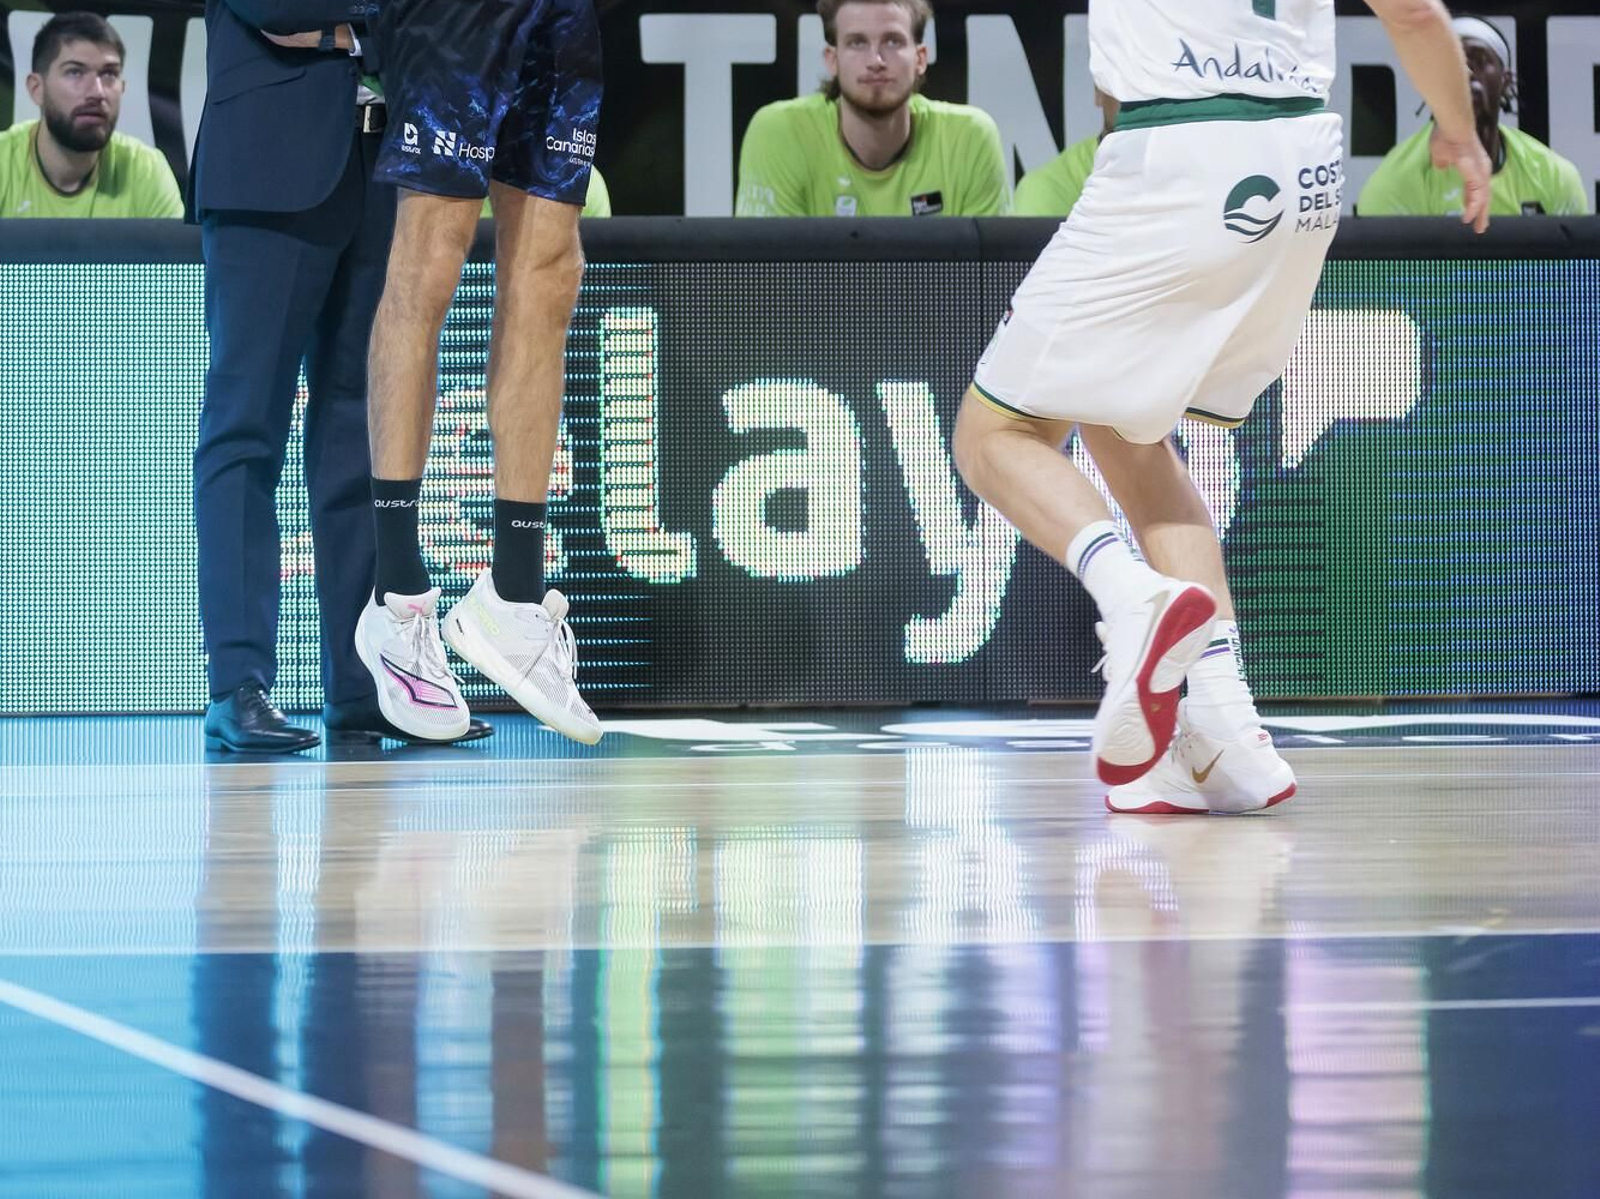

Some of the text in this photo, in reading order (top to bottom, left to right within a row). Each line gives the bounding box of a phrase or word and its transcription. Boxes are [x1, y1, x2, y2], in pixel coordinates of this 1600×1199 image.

[546, 136, 596, 157] Canarias
[1299, 191, 1333, 213] DEL
[1294, 210, 1338, 233] MÁL
